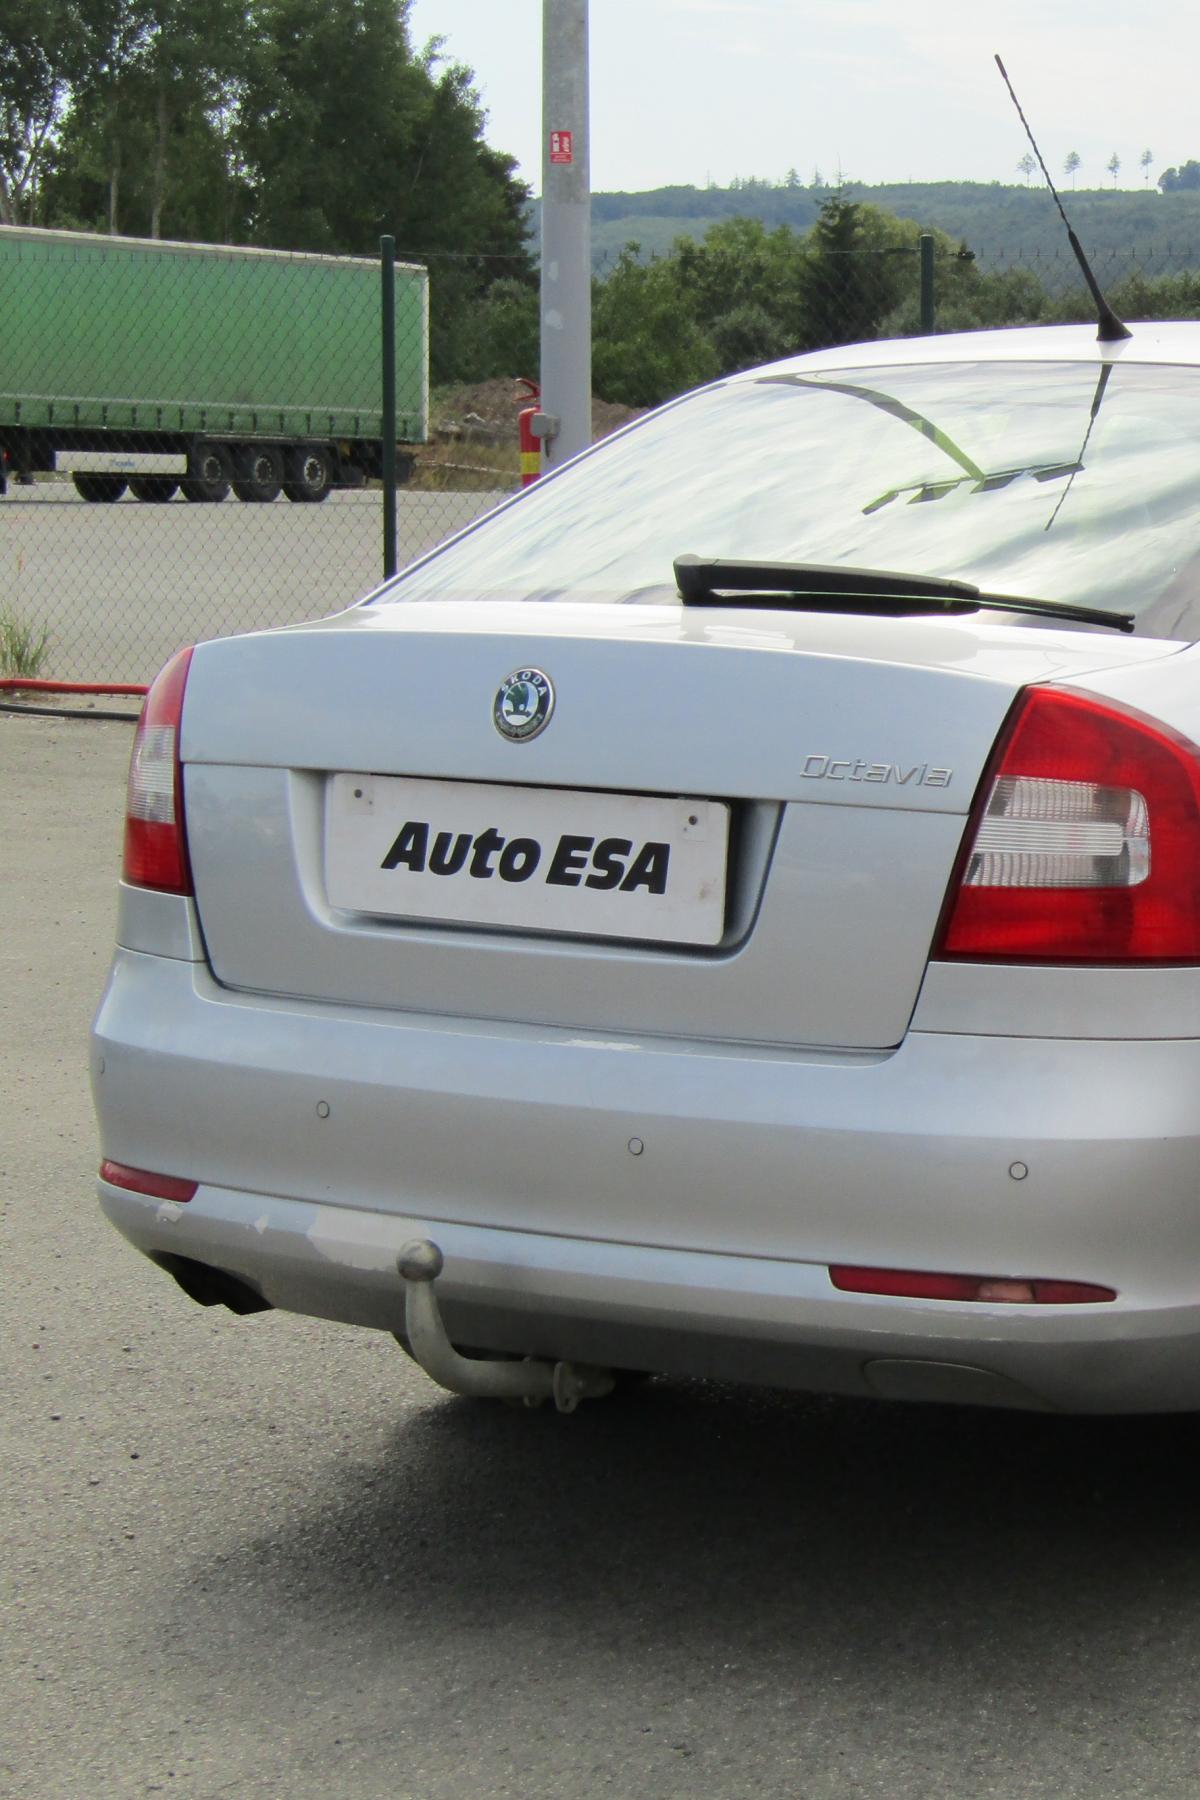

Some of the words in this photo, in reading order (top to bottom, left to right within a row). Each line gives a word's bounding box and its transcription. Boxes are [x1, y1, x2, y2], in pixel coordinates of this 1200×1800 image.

[800, 754, 953, 787] Octavia
[380, 821, 541, 883] Auto
[545, 834, 671, 895] ESA
